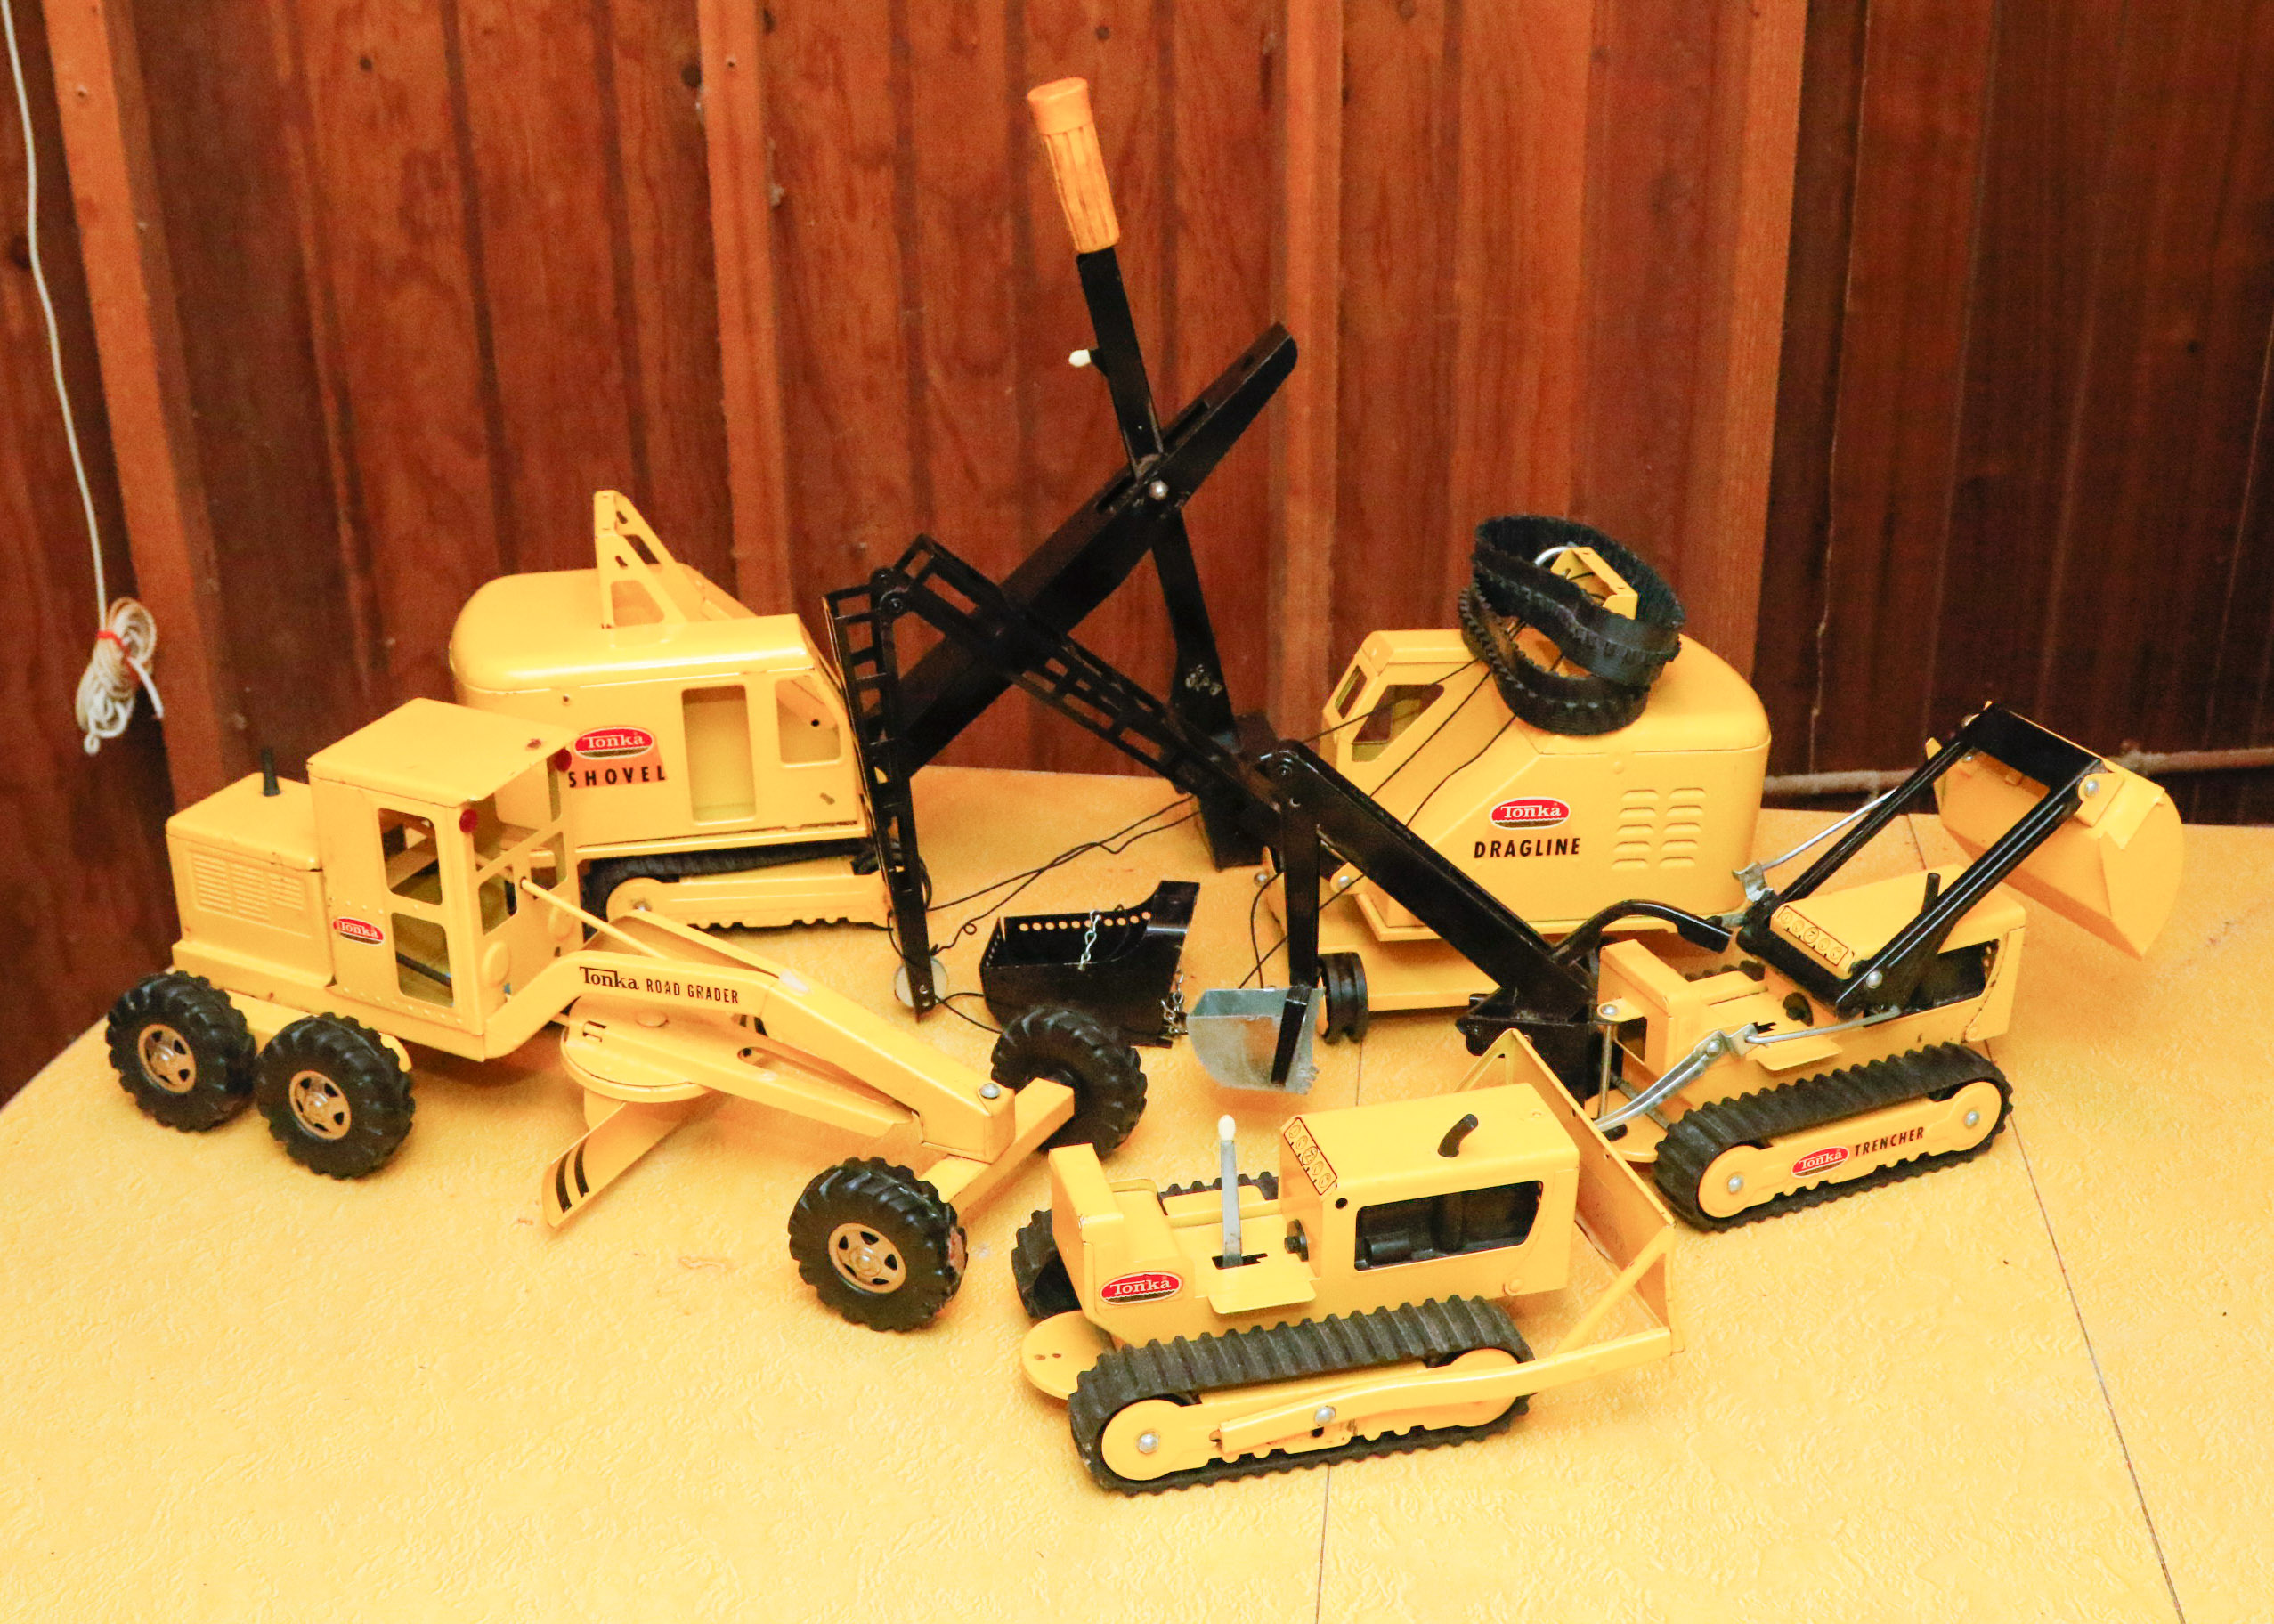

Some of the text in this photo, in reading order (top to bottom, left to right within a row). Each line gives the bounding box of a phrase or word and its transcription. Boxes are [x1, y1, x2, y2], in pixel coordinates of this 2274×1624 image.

[581, 734, 645, 749] Tonka
[568, 765, 666, 788] SHOVEL
[1501, 805, 1561, 818] Tonka
[1474, 837, 1580, 858] DRAGLINE
[339, 921, 378, 938] Tonka
[580, 966, 739, 1004] Tonka ROAD GRADER
[1799, 1126, 1925, 1169] Tonka TRENCHER
[1109, 1280, 1172, 1295] Tonka
